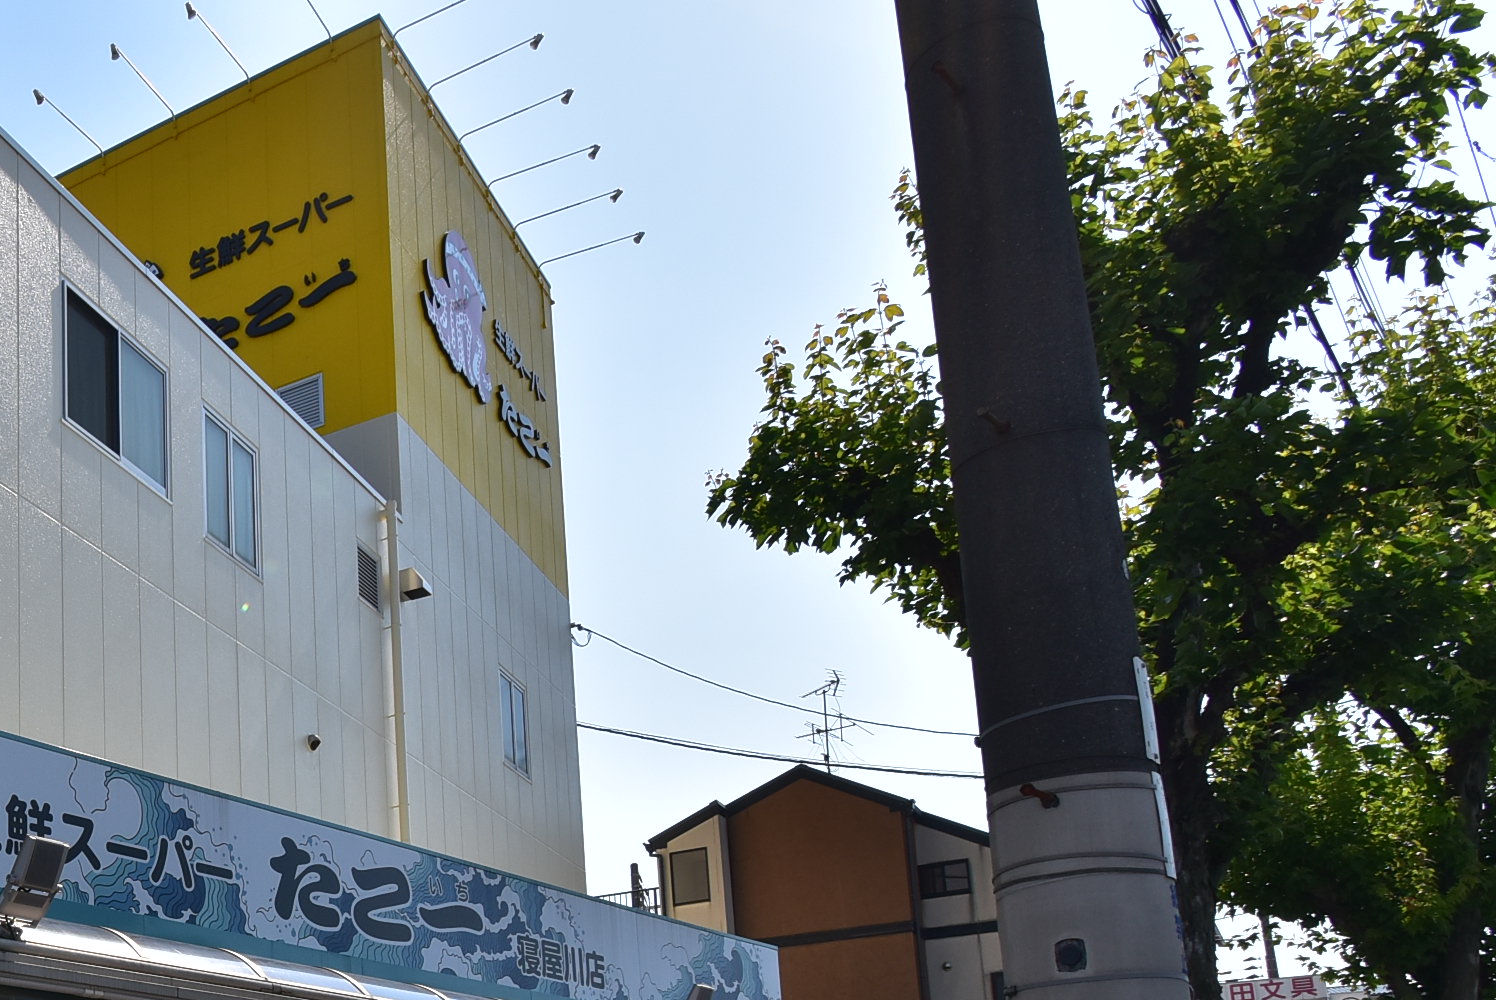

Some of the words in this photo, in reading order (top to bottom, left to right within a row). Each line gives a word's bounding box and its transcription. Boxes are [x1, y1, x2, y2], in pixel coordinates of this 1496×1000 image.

[190, 192, 353, 279] 生鮮スーパー
[517, 933, 606, 990] 寝屋川店
